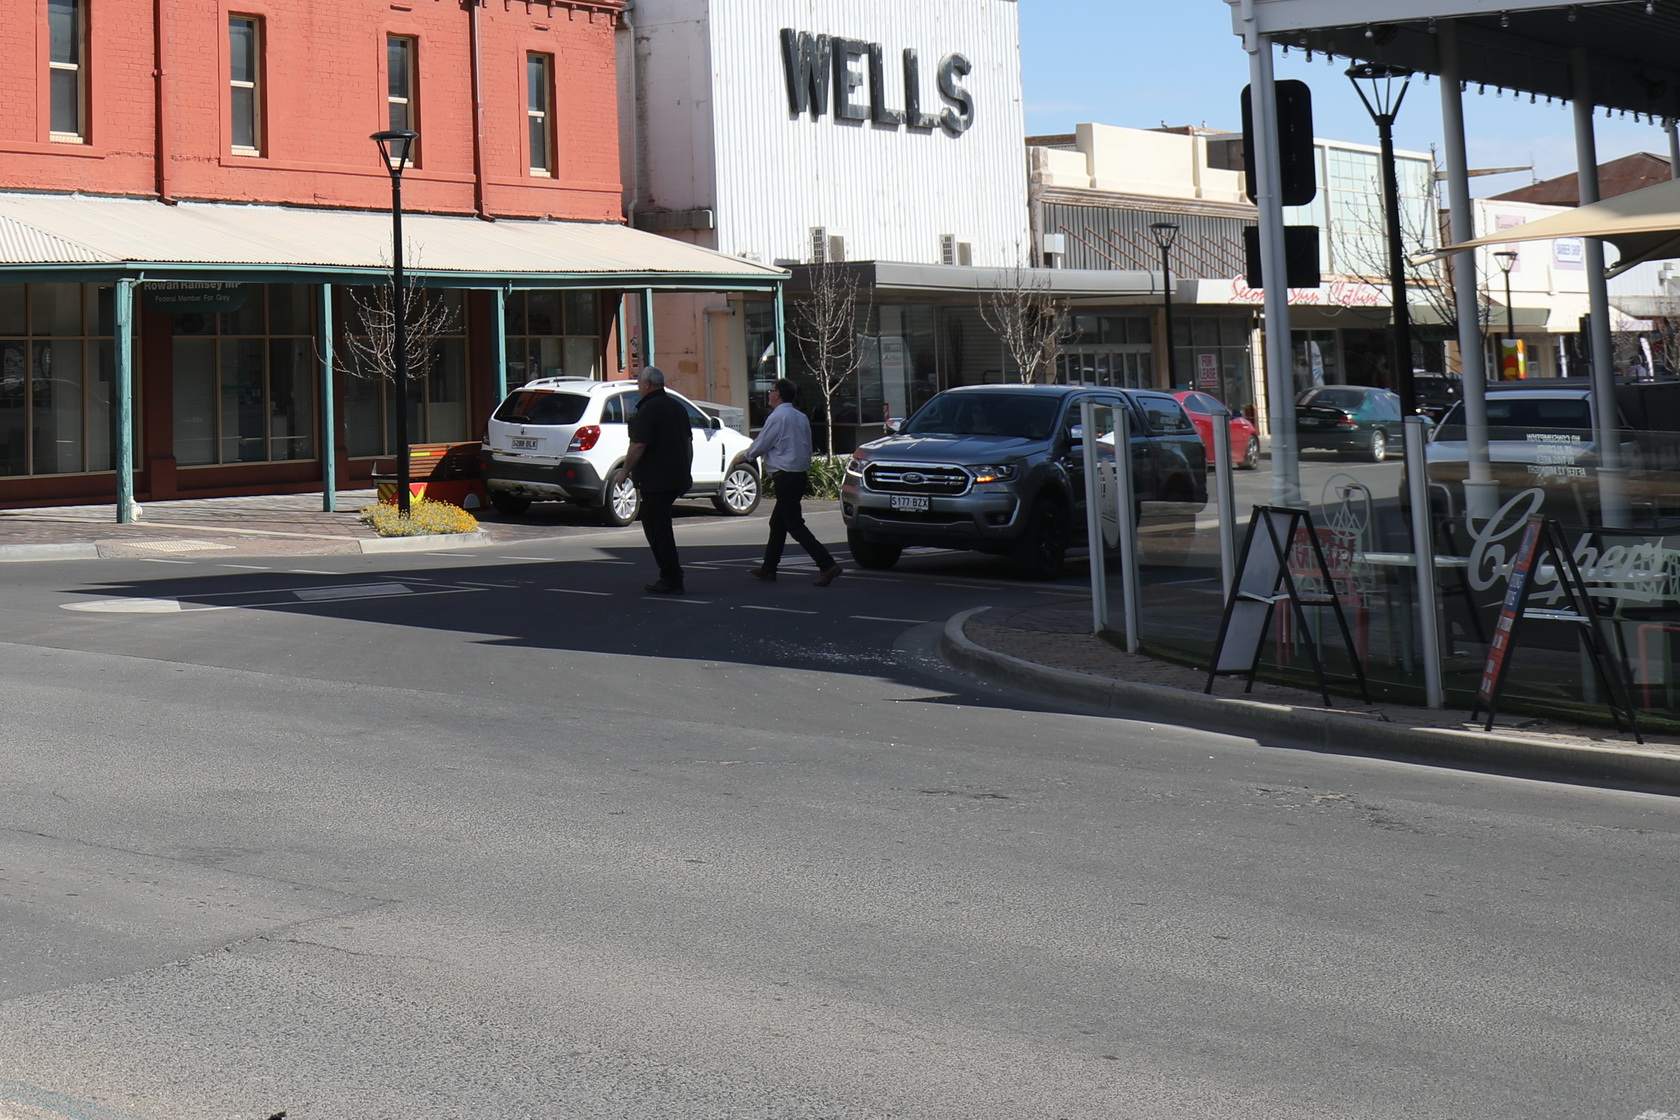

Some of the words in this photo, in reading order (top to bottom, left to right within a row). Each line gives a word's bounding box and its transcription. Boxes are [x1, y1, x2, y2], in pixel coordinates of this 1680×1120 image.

[779, 27, 975, 138] WELLS
[1229, 273, 1265, 302] Secon
[155, 295, 177, 303] Federal
[216, 294, 230, 302] Grey
[1201, 355, 1213, 367] FOR
[1200, 367, 1217, 380] LEASE
[891, 496, 910, 506] S177
[912, 498, 928, 508] BZX
